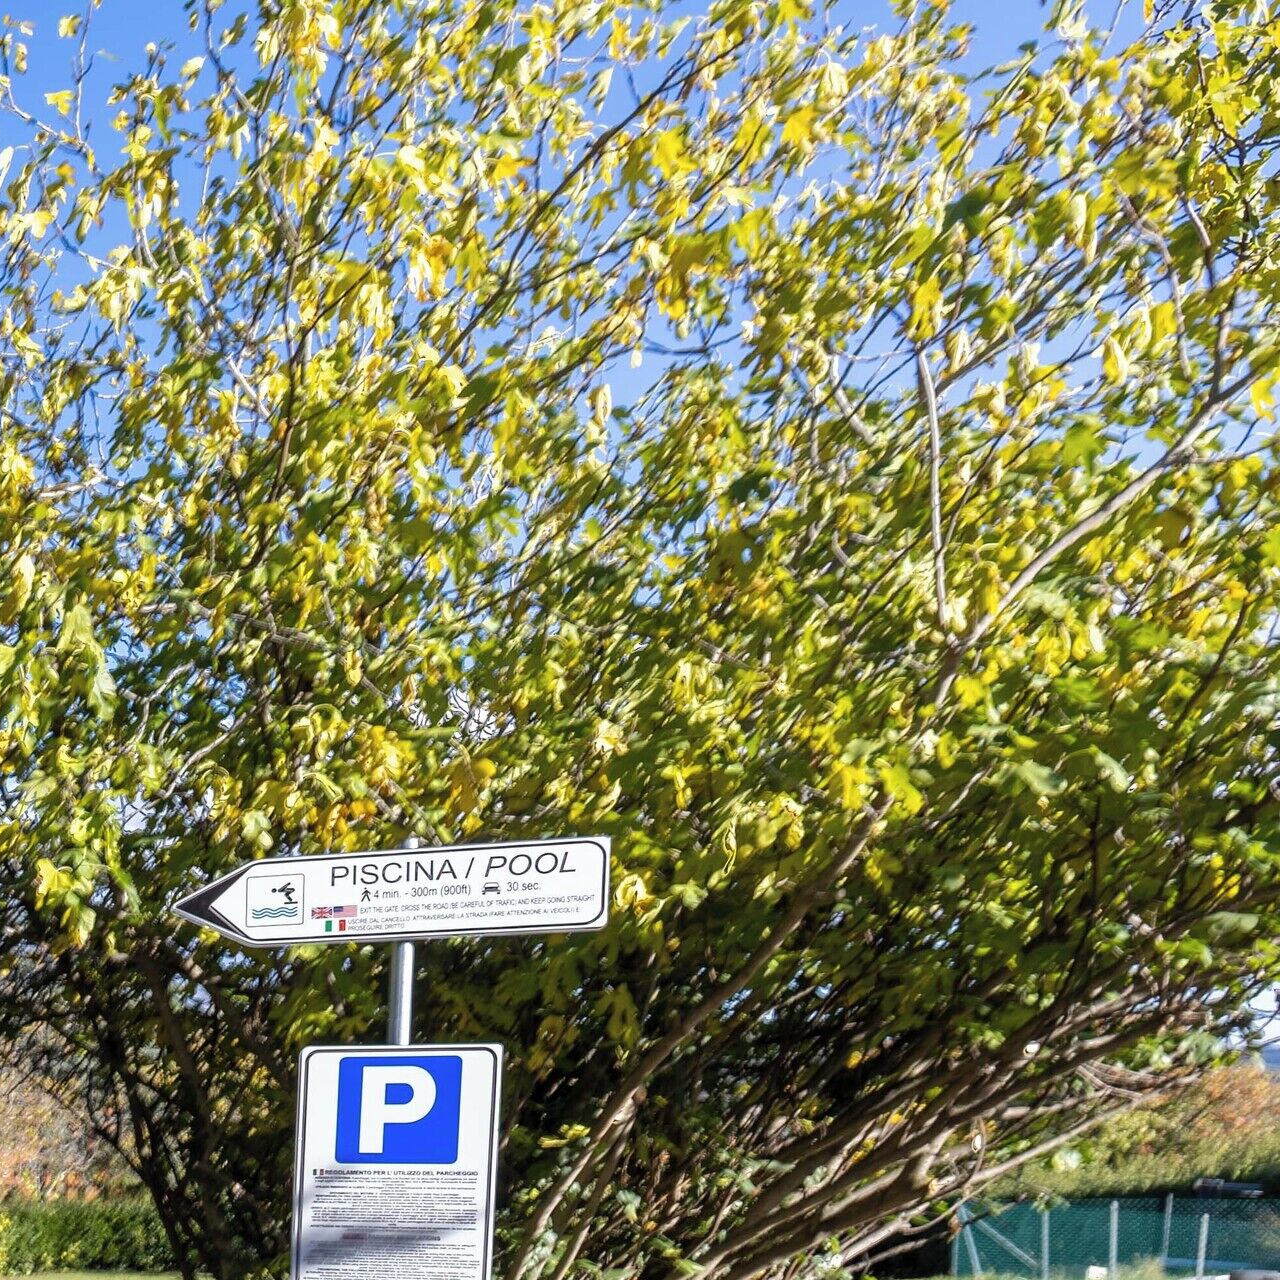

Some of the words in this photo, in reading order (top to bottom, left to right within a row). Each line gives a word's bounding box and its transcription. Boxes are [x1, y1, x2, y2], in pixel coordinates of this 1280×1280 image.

[330, 859, 457, 887] PISCINA
[464, 857, 475, 879] /
[485, 851, 577, 878] POOL
[373, 889, 381, 899] 4
[382, 888, 402, 899] min.
[411, 886, 438, 897] 300m
[439, 884, 471, 897] (900ft)
[506, 882, 519, 892] 30
[521, 881, 541, 891] sec.
[421, 903, 431, 911] THE
[433, 902, 448, 910] ROAD
[460, 900, 485, 908] CAREFUL
[518, 897, 529, 905] AND
[530, 896, 545, 904] KEEP
[546, 896, 565, 904] GOING
[566, 894, 595, 902] STRAIGHT
[358, 1065, 437, 1154] P
